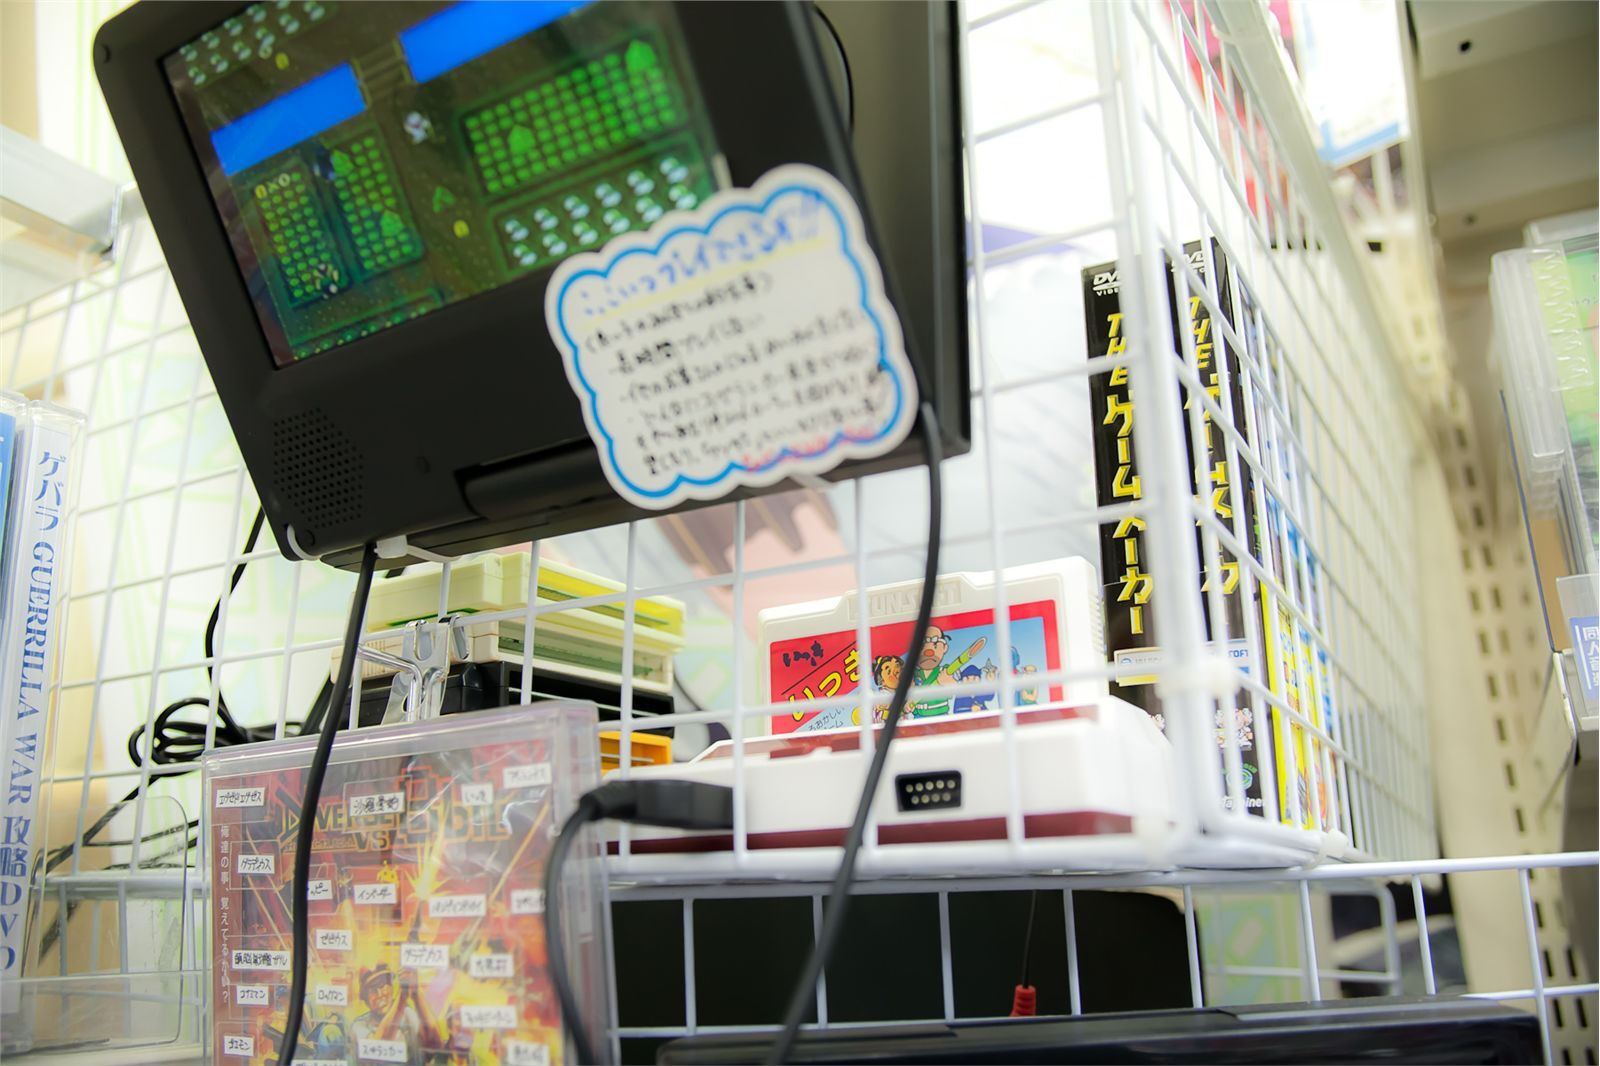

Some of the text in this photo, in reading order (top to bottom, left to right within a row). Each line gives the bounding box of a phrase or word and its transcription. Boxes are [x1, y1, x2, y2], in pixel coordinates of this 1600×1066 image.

[1094, 271, 1121, 285] DV
[1096, 288, 1120, 297] VIDE
[1106, 313, 1129, 387] THE
[35, 451, 67, 531] ゲバラ
[17, 541, 55, 720] GUERRILLA
[782, 640, 824, 668] いっき
[788, 648, 860, 722] いっき
[8, 732, 38, 805] WAR
[356, 830, 391, 852] VS
[320, 933, 348, 946] ゼビウス
[317, 989, 345, 1001] ロックマン
